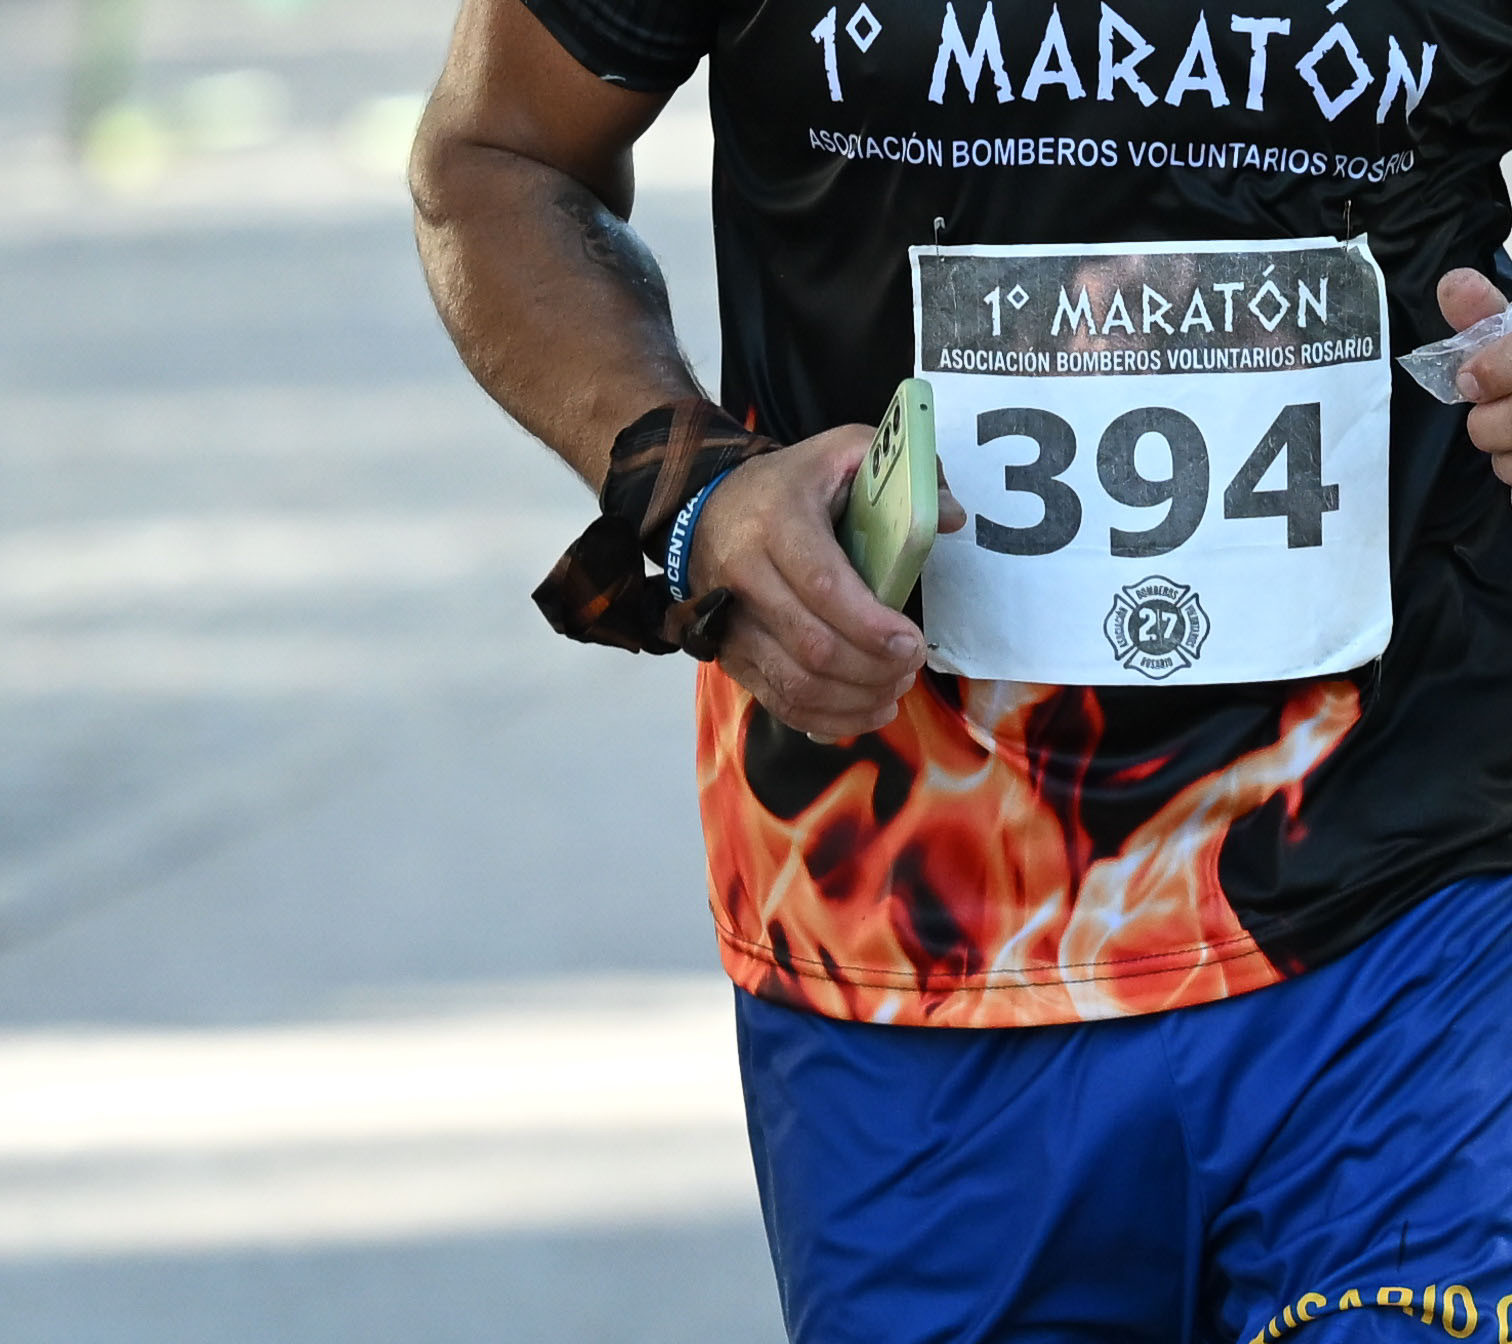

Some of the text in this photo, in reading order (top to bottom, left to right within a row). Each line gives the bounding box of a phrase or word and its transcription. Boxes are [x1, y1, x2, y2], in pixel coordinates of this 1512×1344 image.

[809, 127, 1415, 183] ASOCIACIÓN BOMBEROS VOLUNTARIOS ROSRIO
[1050, 264, 1329, 336] MARATÓN
[940, 336, 1375, 373] ASOCIACIÓN BOMBEROS VOLUNTARIOS ROSARIO
[974, 402, 1340, 558] 394
[667, 485, 706, 583] CENTRA
[1139, 607, 1178, 642] 27
